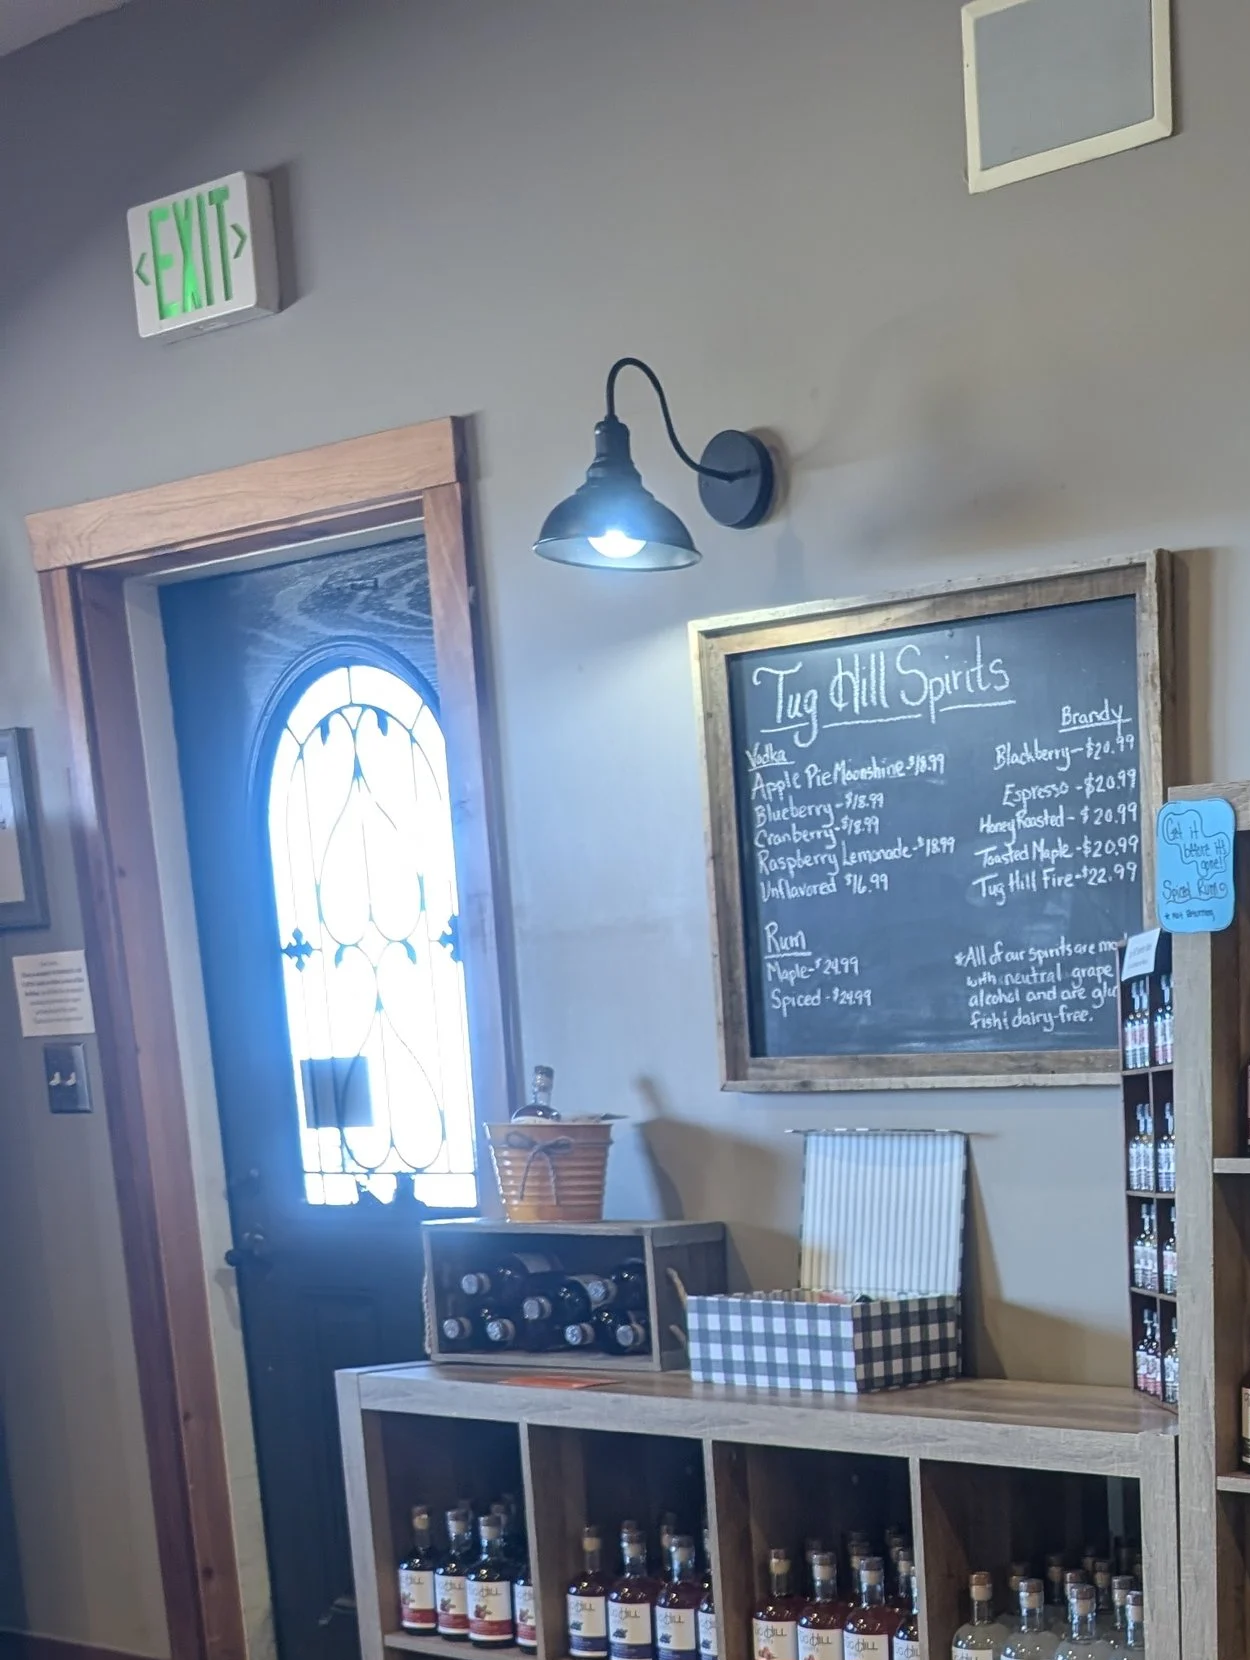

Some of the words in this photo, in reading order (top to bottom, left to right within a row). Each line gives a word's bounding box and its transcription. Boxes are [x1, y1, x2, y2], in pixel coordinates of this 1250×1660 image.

[148, 186, 234, 320] EXIT
[753, 662, 819, 747] Tug
[829, 651, 889, 714] Hill
[896, 636, 1011, 724] Spirits
[1061, 698, 1122, 736] Brandy
[746, 742, 787, 767] Vodka
[751, 772, 801, 801] Apple
[804, 764, 832, 788] Pie
[1002, 782, 1069, 810] Espresso
[980, 814, 1016, 846] Honey
[758, 849, 839, 878] Raspberry
[974, 844, 1028, 868] Toasted
[761, 877, 837, 902] Unflavored
[844, 873, 888, 894] $16.99
[972, 874, 1006, 905] Tug
[1009, 870, 1036, 891] Hill
[765, 922, 806, 953] Rum
[1028, 936, 1073, 966] spirits
[1074, 944, 1095, 954] are
[1004, 963, 1061, 985] neutral
[1072, 964, 1113, 989] grape
[771, 988, 821, 1017] Spiced
[968, 985, 1019, 1007] alcohol
[1026, 986, 1056, 1001] and
[1061, 987, 1086, 1000] are
